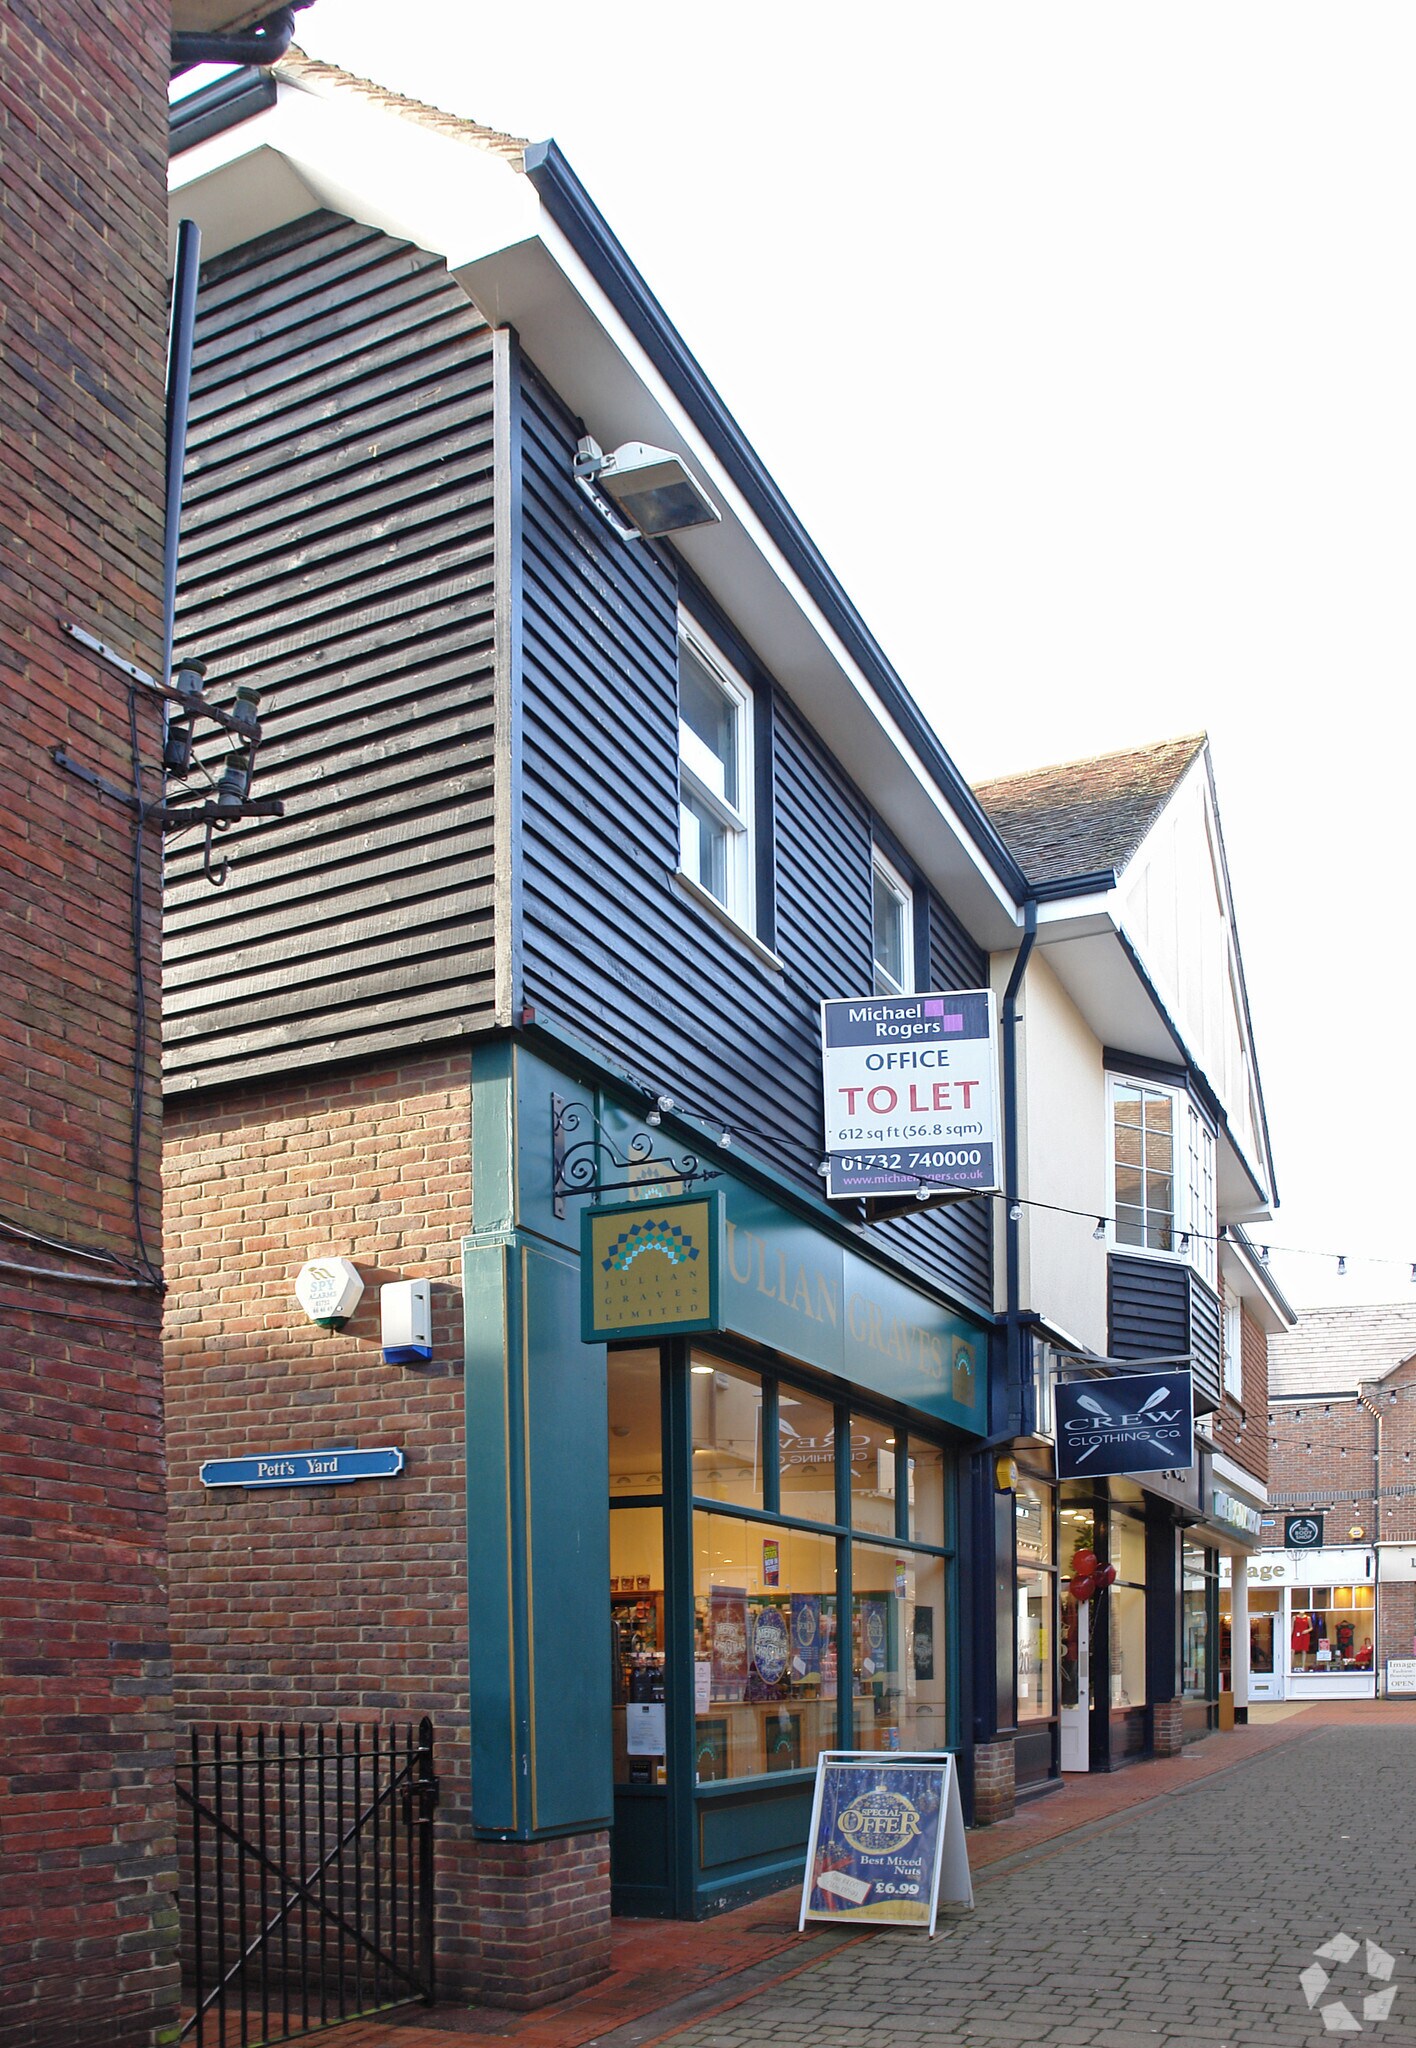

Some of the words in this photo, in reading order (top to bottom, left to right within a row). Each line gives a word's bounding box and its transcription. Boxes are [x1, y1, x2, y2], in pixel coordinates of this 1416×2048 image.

[849, 1004, 921, 1022] Michael
[876, 1021, 940, 1039] Rogers
[865, 1050, 950, 1070] OFFICE
[838, 1085, 898, 1115] TO
[910, 1081, 979, 1112] LET
[838, 1128, 864, 1140] 612
[902, 1124, 942, 1140] (56.8
[946, 1122, 983, 1138] sqm)
[841, 1154, 902, 1171] 01732
[909, 1149, 981, 1168] 740000
[310, 1280, 335, 1292] SPY
[604, 1270, 697, 1289] JULIAN
[604, 1288, 698, 1304] GRAVES
[726, 1219, 838, 1329] ULIAN
[850, 1292, 943, 1380] GRAVES
[605, 1304, 698, 1321] LIMITED
[1064, 1409, 1183, 1431] CREW
[1068, 1431, 1150, 1447] CLOTHING
[258, 1461, 295, 1477] Pett's
[306, 1457, 338, 1474] Yard
[1389, 1661, 1416, 1669] Image
[861, 1808, 900, 1817] SPECIAL
[837, 1809, 922, 1836] OFFER
[860, 1855, 884, 1865] Best
[887, 1856, 922, 1867] Mixed
[893, 1865, 921, 1876] Nuts
[875, 1882, 920, 1895] £6.99
